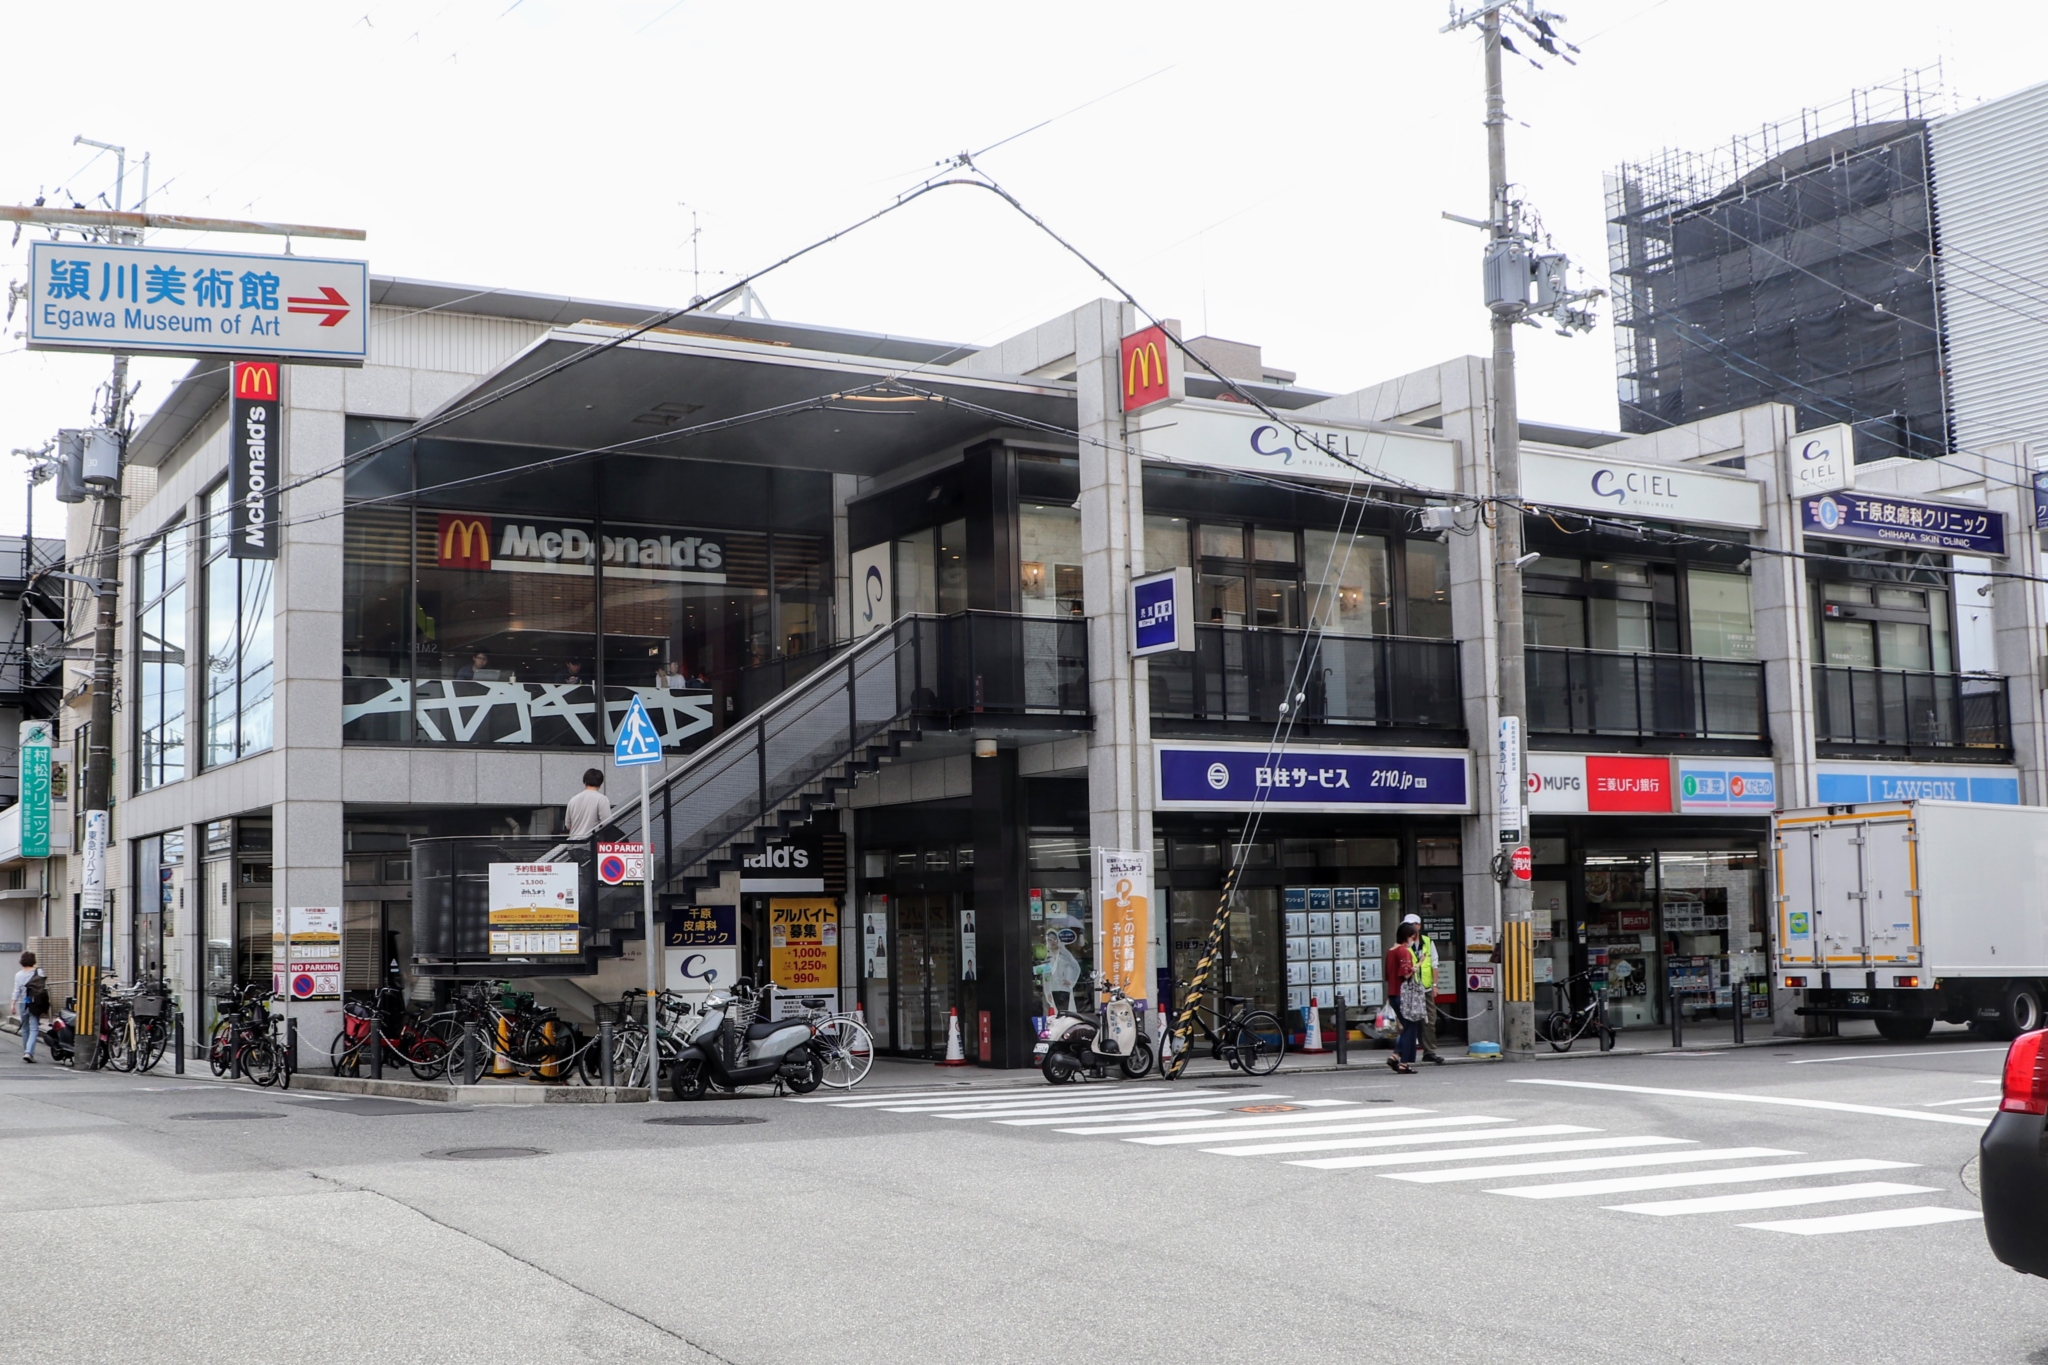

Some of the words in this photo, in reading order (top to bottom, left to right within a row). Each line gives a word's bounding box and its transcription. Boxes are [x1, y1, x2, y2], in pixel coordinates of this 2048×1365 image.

[47, 258, 280, 311] 頴川美術館
[44, 304, 115, 330] Egawa
[124, 308, 212, 333] Museum
[220, 314, 242, 334] of
[250, 315, 280, 337] Art
[1294, 429, 1359, 458] CIEL
[246, 406, 266, 547] McDonald's
[1800, 464, 1836, 481] CIEL
[1626, 473, 1678, 497] CIEL
[1855, 501, 1988, 534] 千原皮膚科クリニック
[499, 524, 722, 569] McDonald's
[1878, 528, 1917, 541] CHIHARA
[1920, 534, 1940, 544] SKIN
[1943, 536, 1971, 547] CLINIC
[1255, 767, 1350, 788] 日住サービス
[1370, 770, 1413, 790] 2110.jp
[1543, 776, 1581, 790] MUFG
[1597, 777, 1660, 792] 三菱UFJ銀行
[33, 748, 48, 845] 村松クリニック
[1882, 780, 1956, 800] LAWSON
[599, 844, 612, 852] NO
[614, 844, 644, 852] PARKIN
[1512, 857, 1531, 871] 消火
[689, 907, 712, 919] 千原
[773, 908, 834, 923] アルバイト
[683, 920, 717, 932] 皮膚科
[790, 924, 817, 939] 募集
[672, 932, 728, 944] クリニック
